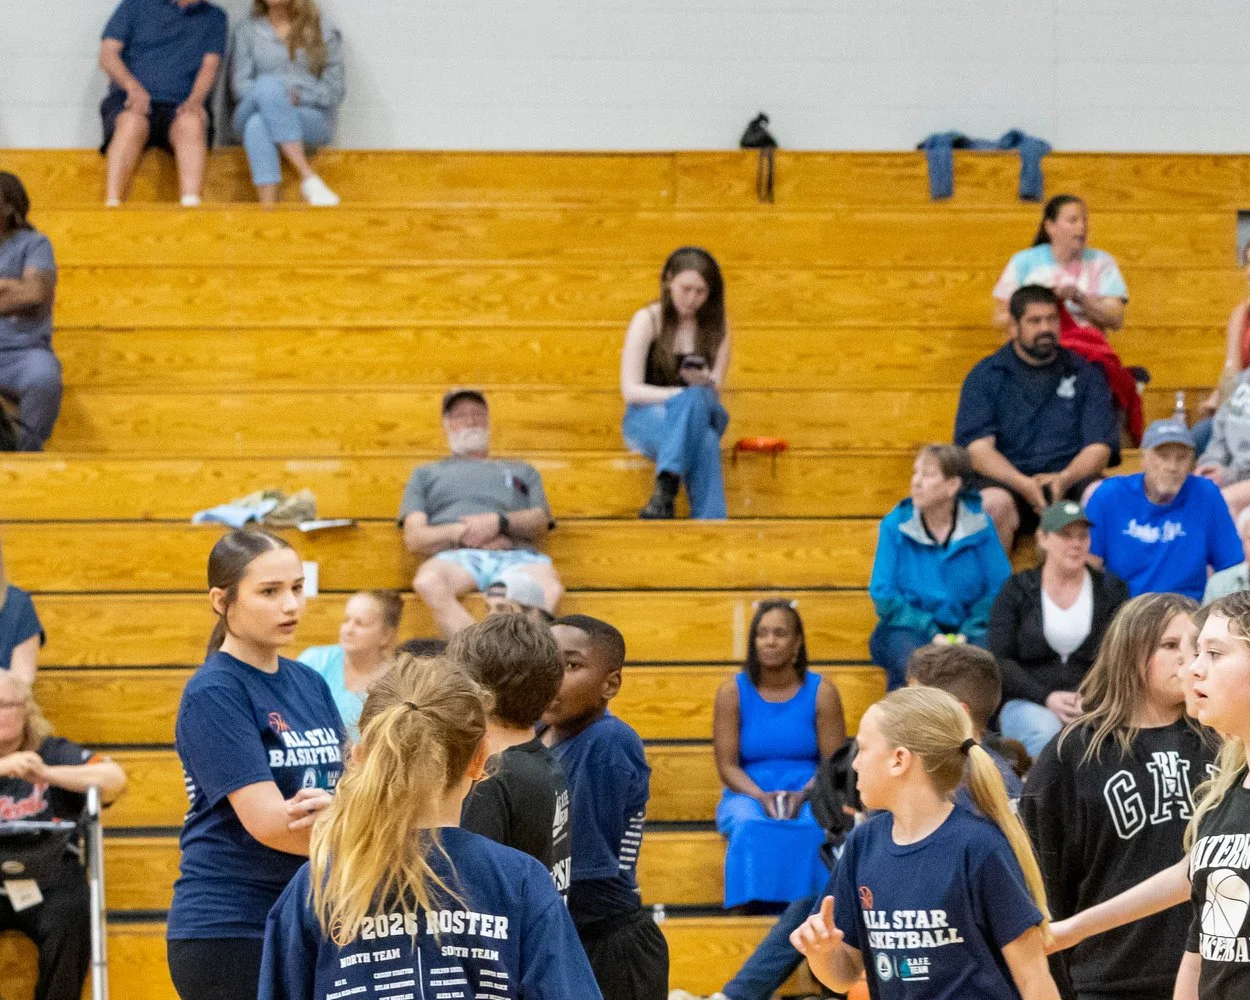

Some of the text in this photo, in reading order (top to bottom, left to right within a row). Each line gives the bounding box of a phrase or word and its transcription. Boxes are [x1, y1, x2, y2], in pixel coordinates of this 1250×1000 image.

[1103, 757, 1221, 840] GA
[425, 909, 509, 940] ROSTER
[892, 909, 949, 930] STAR
[340, 947, 401, 969] NORTH TEAM
[471, 947, 499, 961] TEAM
